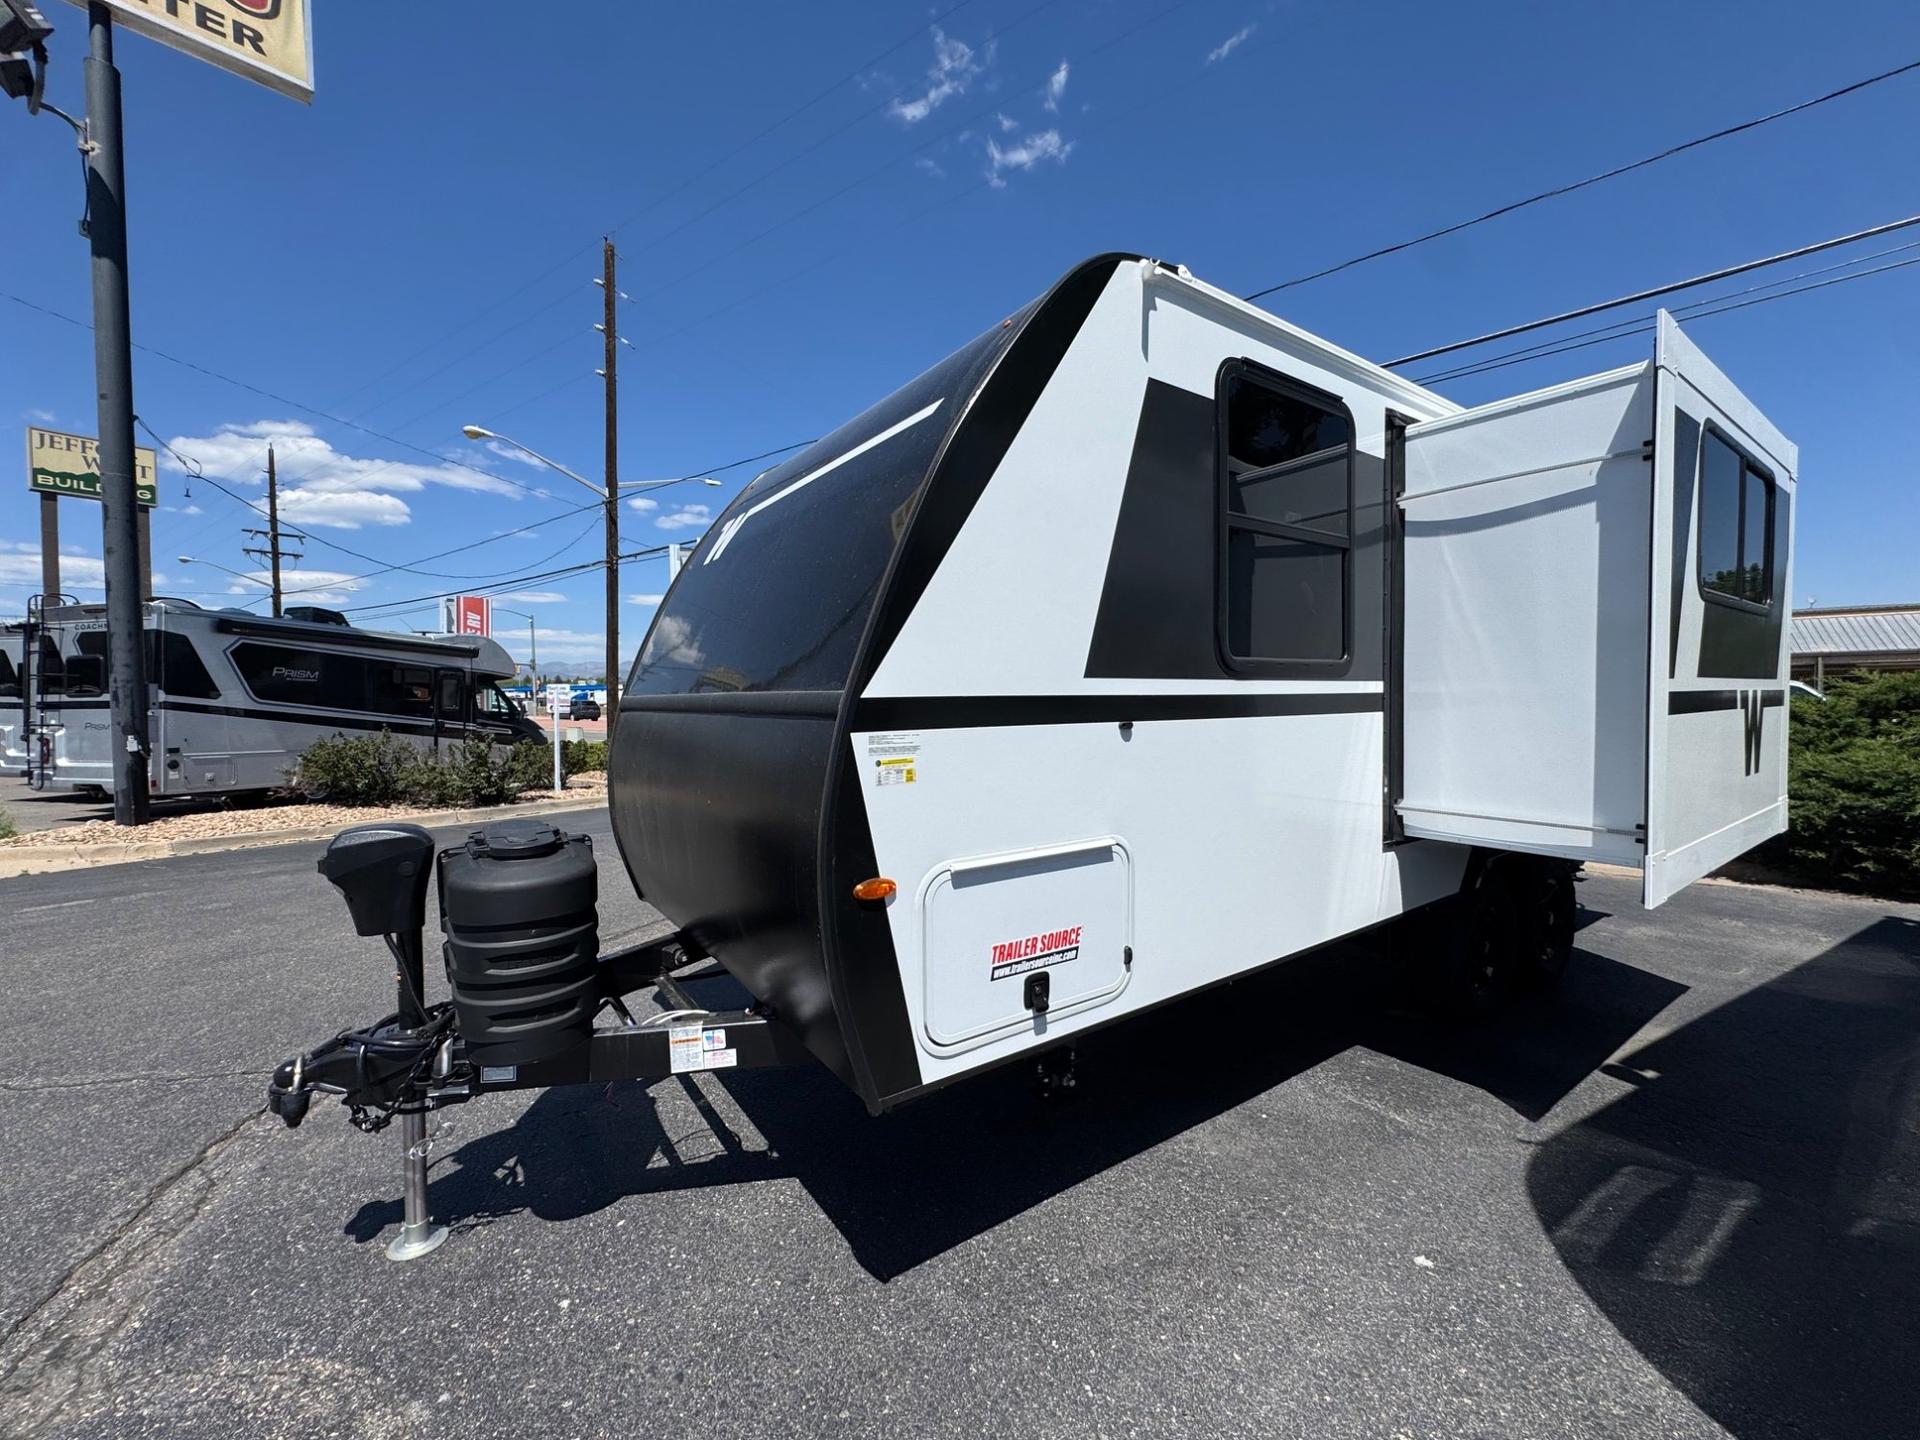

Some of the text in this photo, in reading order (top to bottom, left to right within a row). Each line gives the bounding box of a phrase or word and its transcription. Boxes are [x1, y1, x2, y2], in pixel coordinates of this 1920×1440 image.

[37, 475, 152, 499] BUILG
[272, 666, 320, 679] PRISM
[992, 926, 1082, 965] TRAILER SOURCE
